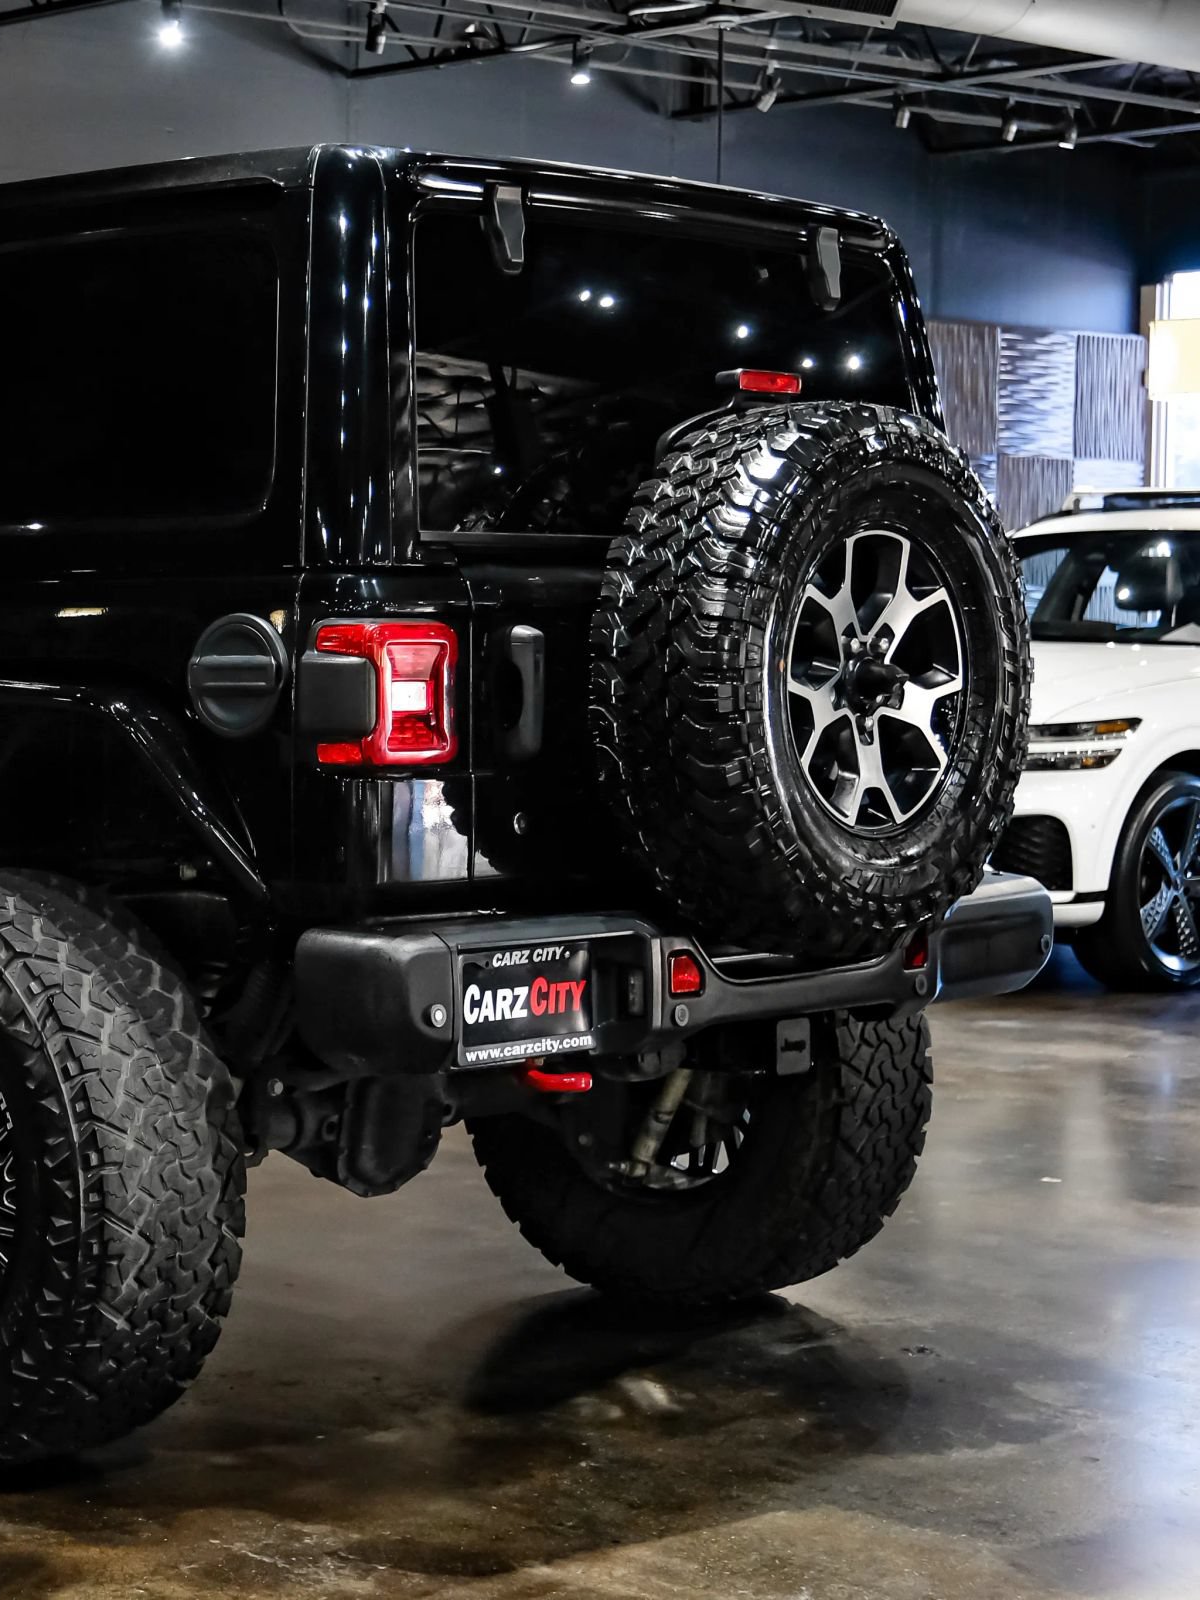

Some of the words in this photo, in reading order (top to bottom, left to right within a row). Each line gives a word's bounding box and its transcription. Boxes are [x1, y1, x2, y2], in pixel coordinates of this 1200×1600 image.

[492, 949, 530, 968] CARZ
[532, 946, 565, 963] CITY
[465, 1034, 593, 1063] www.carzcity.com
